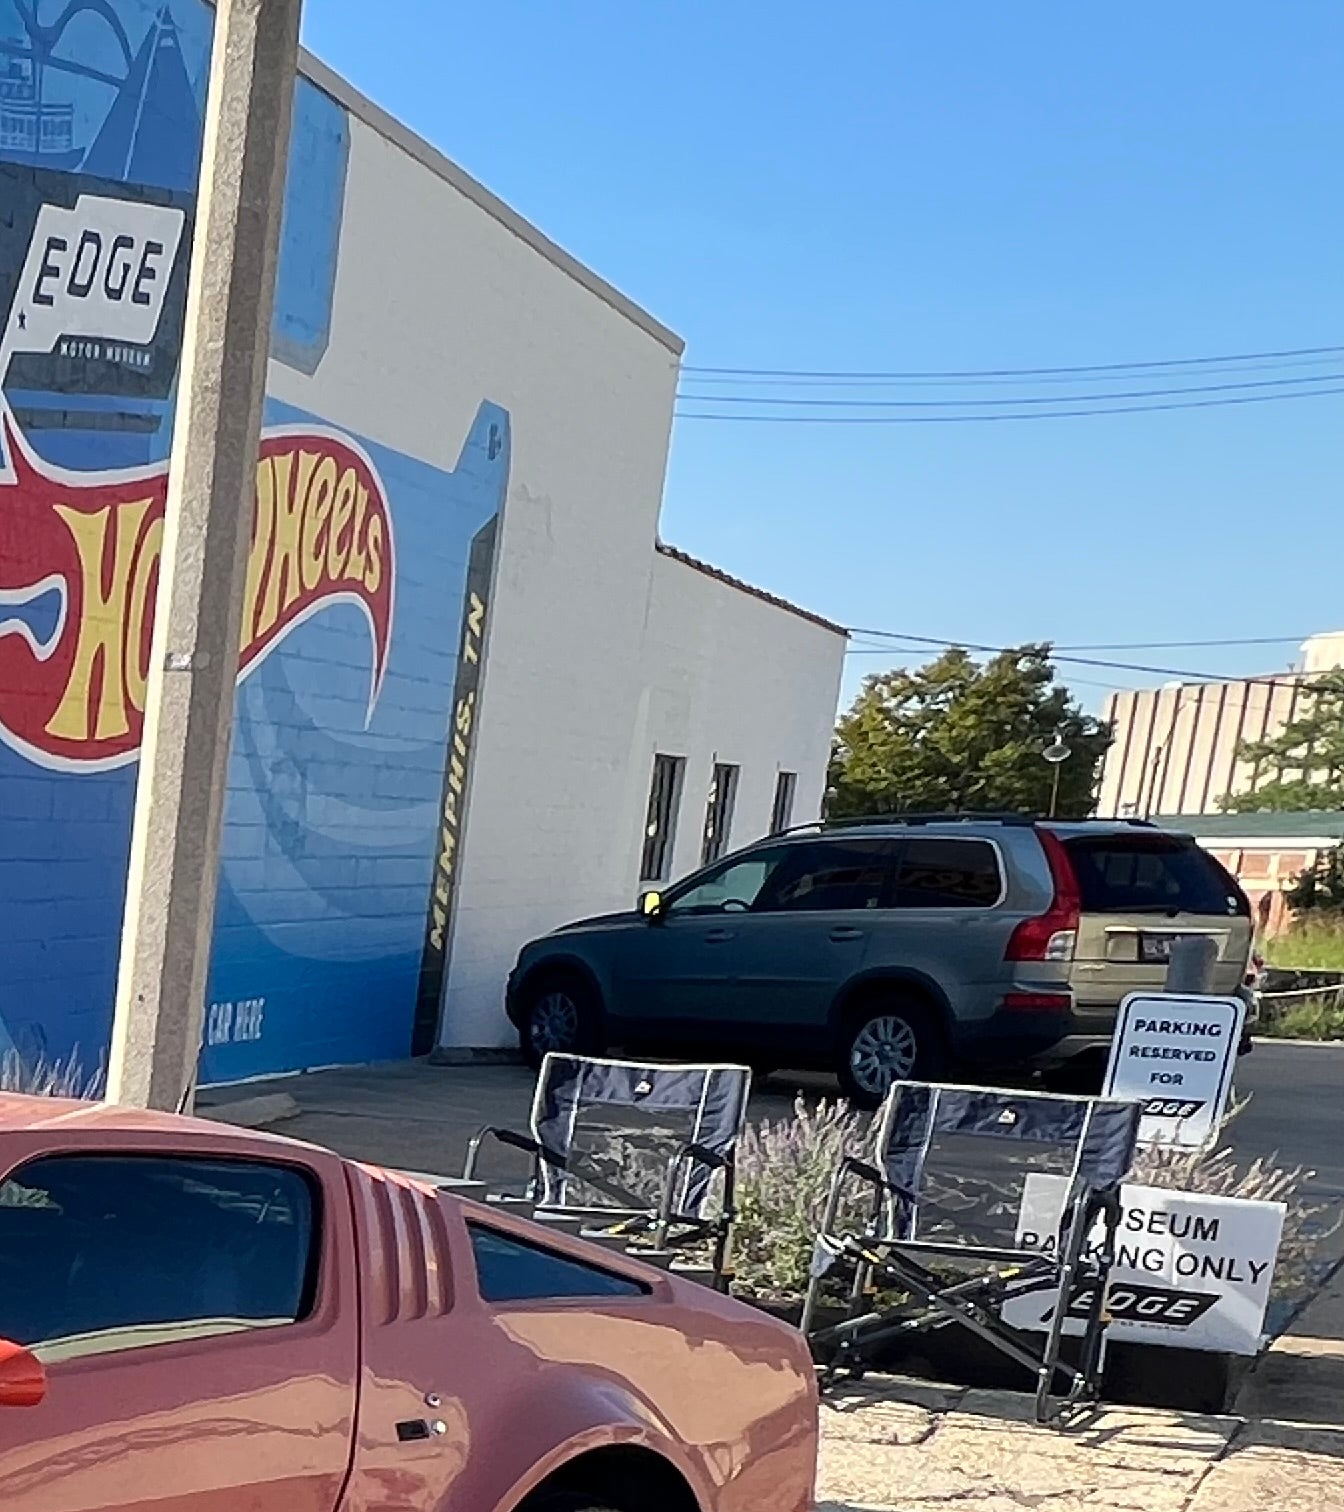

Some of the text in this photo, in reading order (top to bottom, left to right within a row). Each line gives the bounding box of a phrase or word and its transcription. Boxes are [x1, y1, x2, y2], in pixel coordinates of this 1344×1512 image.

[32, 229, 163, 307] EDGE
[45, 496, 165, 741] HO
[462, 592, 484, 665] TN
[1134, 1019, 1222, 1037] PARKING
[1129, 1045, 1216, 1062] RESERVED
[1150, 1072, 1184, 1085] FOR
[1144, 1101, 1196, 1116] DGE
[1176, 1252, 1269, 1284] ONLY
[1070, 1290, 1200, 1318] EDGE
